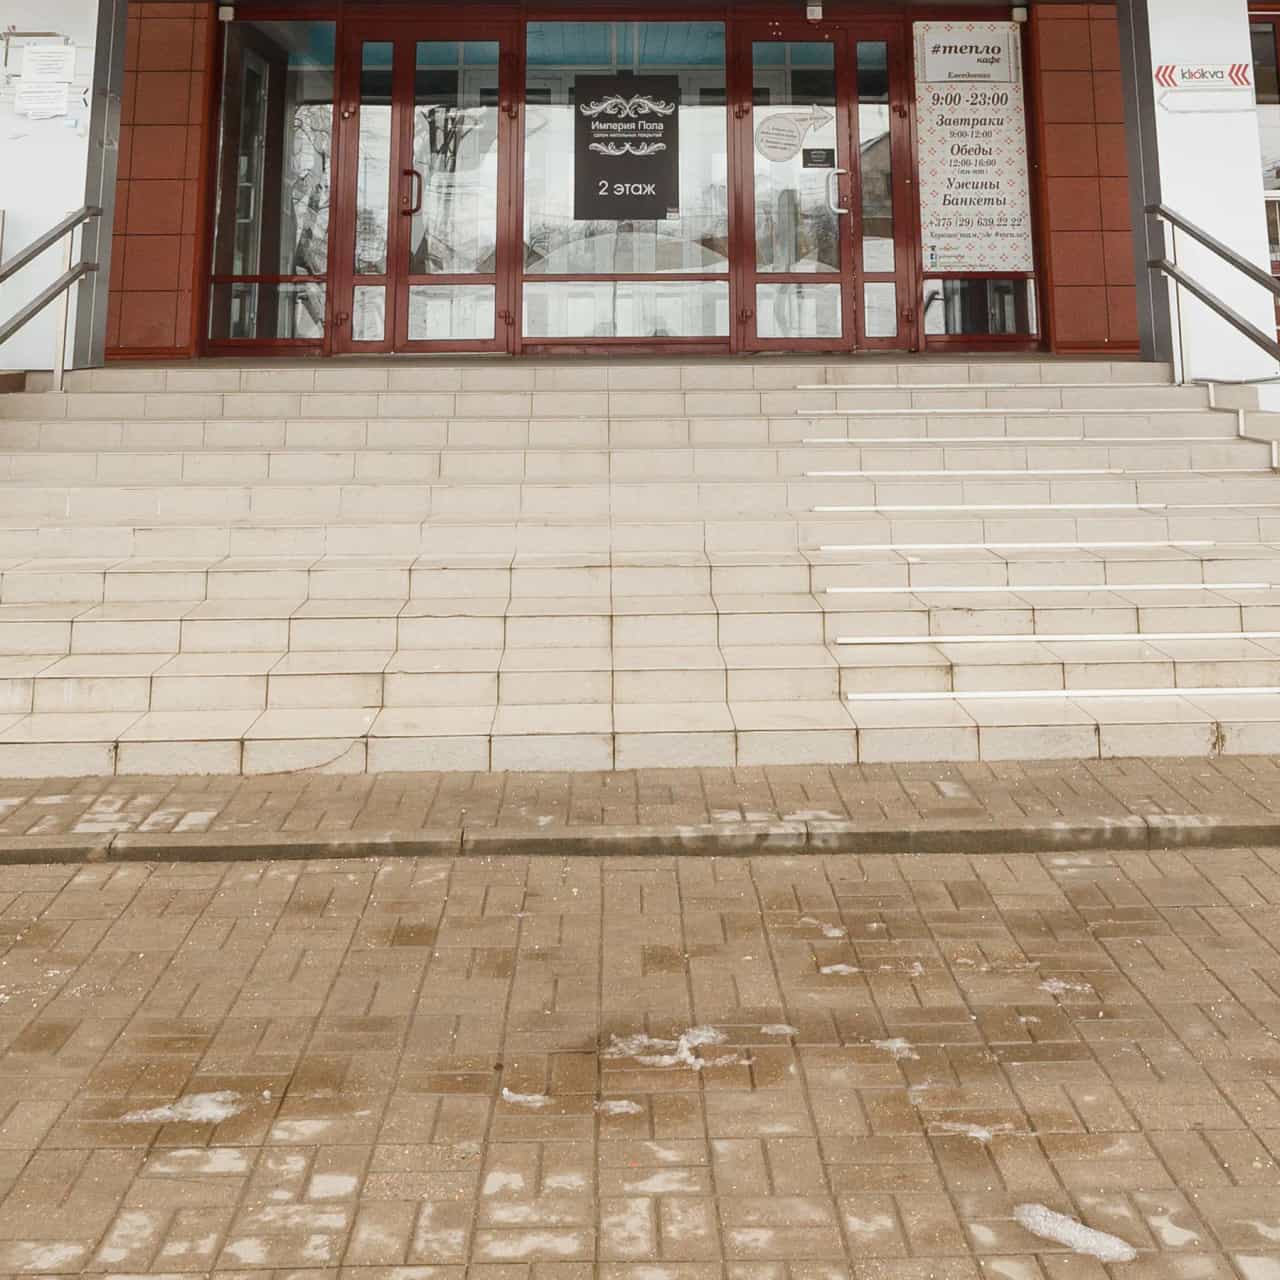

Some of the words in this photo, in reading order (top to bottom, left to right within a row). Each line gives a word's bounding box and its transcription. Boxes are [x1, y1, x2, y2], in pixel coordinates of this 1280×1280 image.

[931, 43, 1001, 55] #тепло
[976, 56, 1000, 66] кафе
[932, 92, 961, 106] 9:00
[591, 120, 635, 132] Империя
[638, 120, 664, 130] Пола
[936, 114, 1004, 128] Завтраки
[950, 144, 993, 156] Обеды
[599, 180, 609, 195] 2
[613, 183, 656, 195] этаж
[946, 177, 1000, 189] Ужины
[942, 193, 1007, 207] Банкеты
